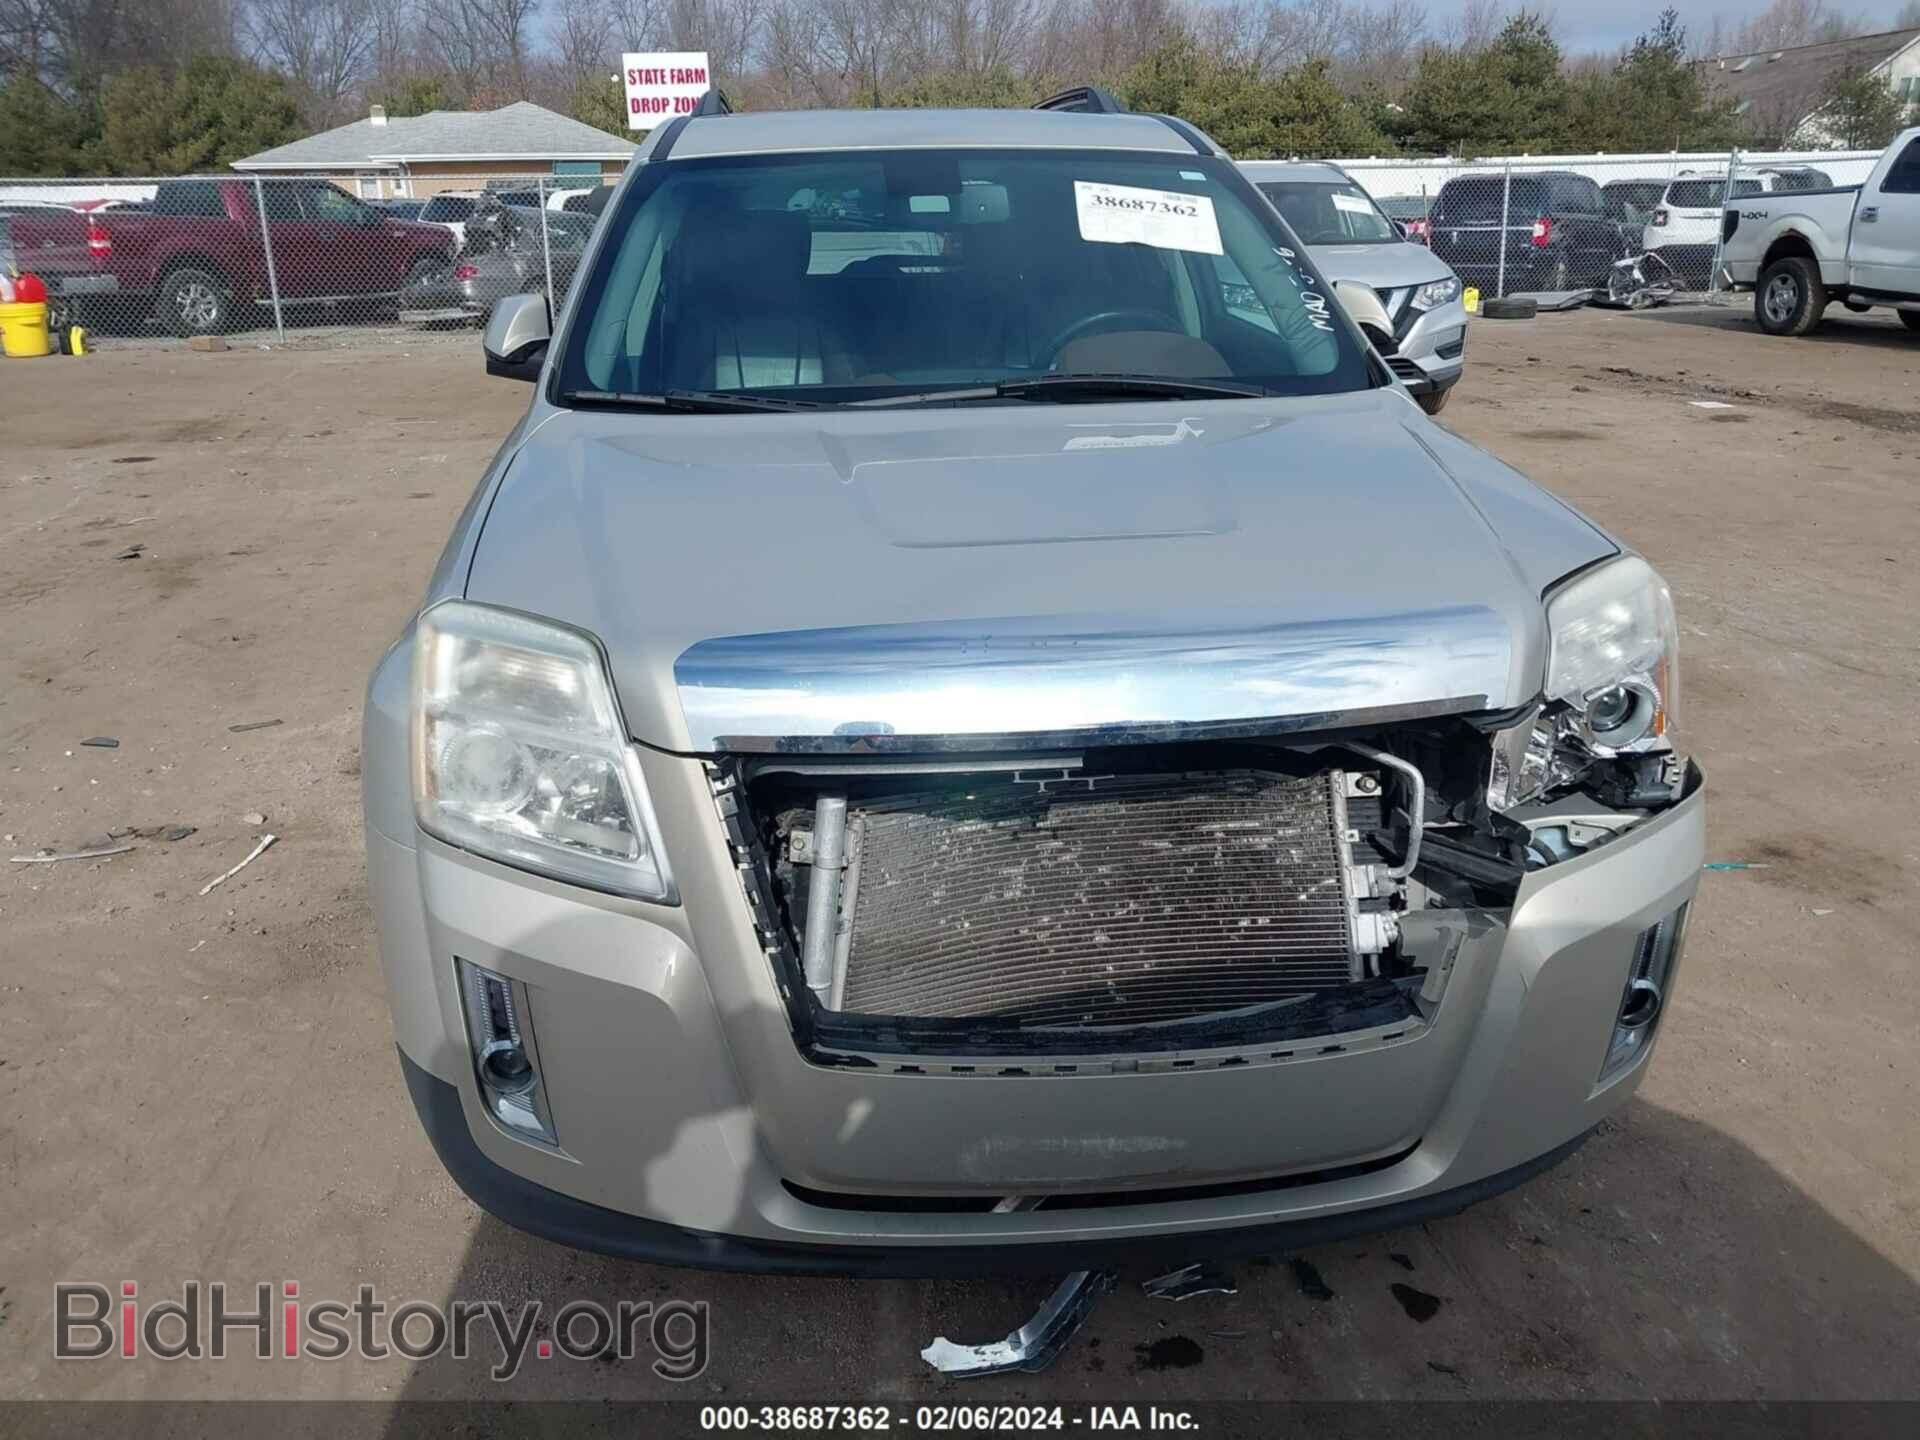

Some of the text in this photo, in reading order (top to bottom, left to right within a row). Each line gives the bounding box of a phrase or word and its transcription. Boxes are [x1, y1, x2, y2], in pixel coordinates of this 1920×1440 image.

[628, 67, 707, 85] STATE FARM
[631, 96, 701, 114] DROP ZON
[1091, 194, 1199, 217] 38687362
